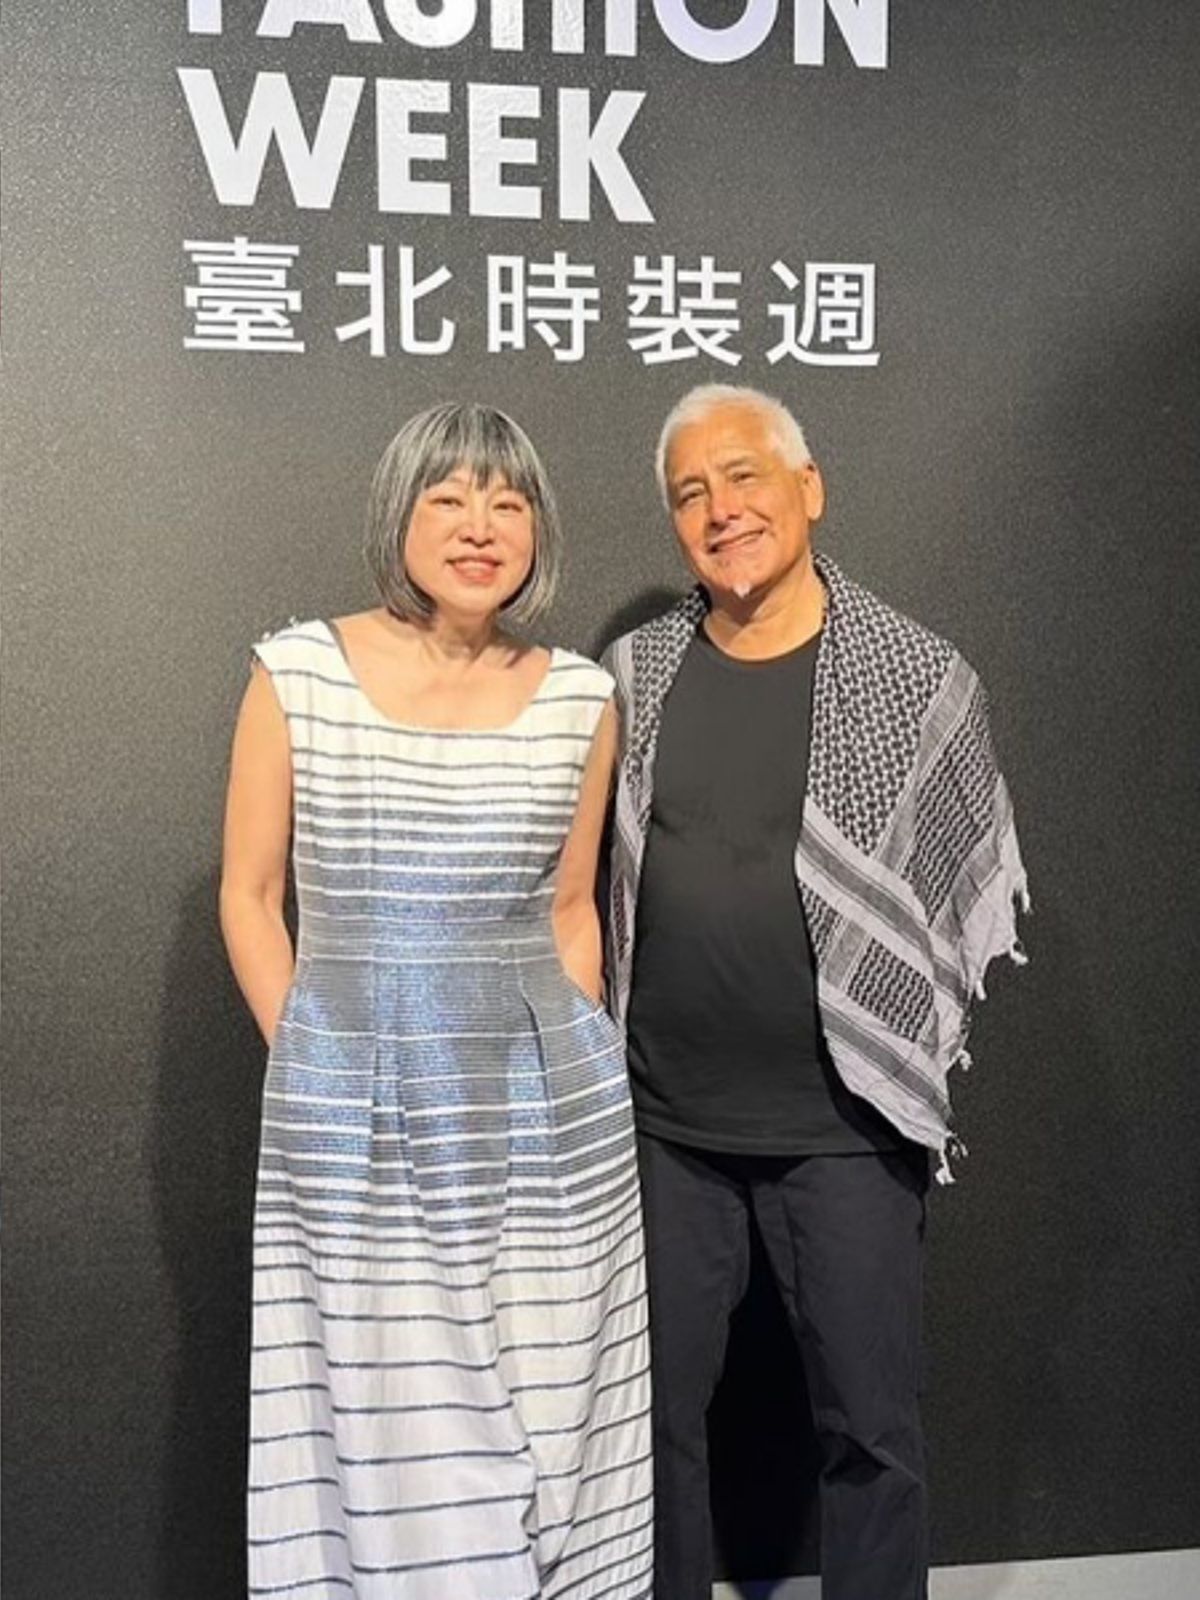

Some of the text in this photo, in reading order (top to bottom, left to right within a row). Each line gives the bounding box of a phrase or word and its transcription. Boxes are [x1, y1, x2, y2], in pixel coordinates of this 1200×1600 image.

[175, 67, 655, 223] WEEK
[182, 236, 881, 367] 臺北時裝週
